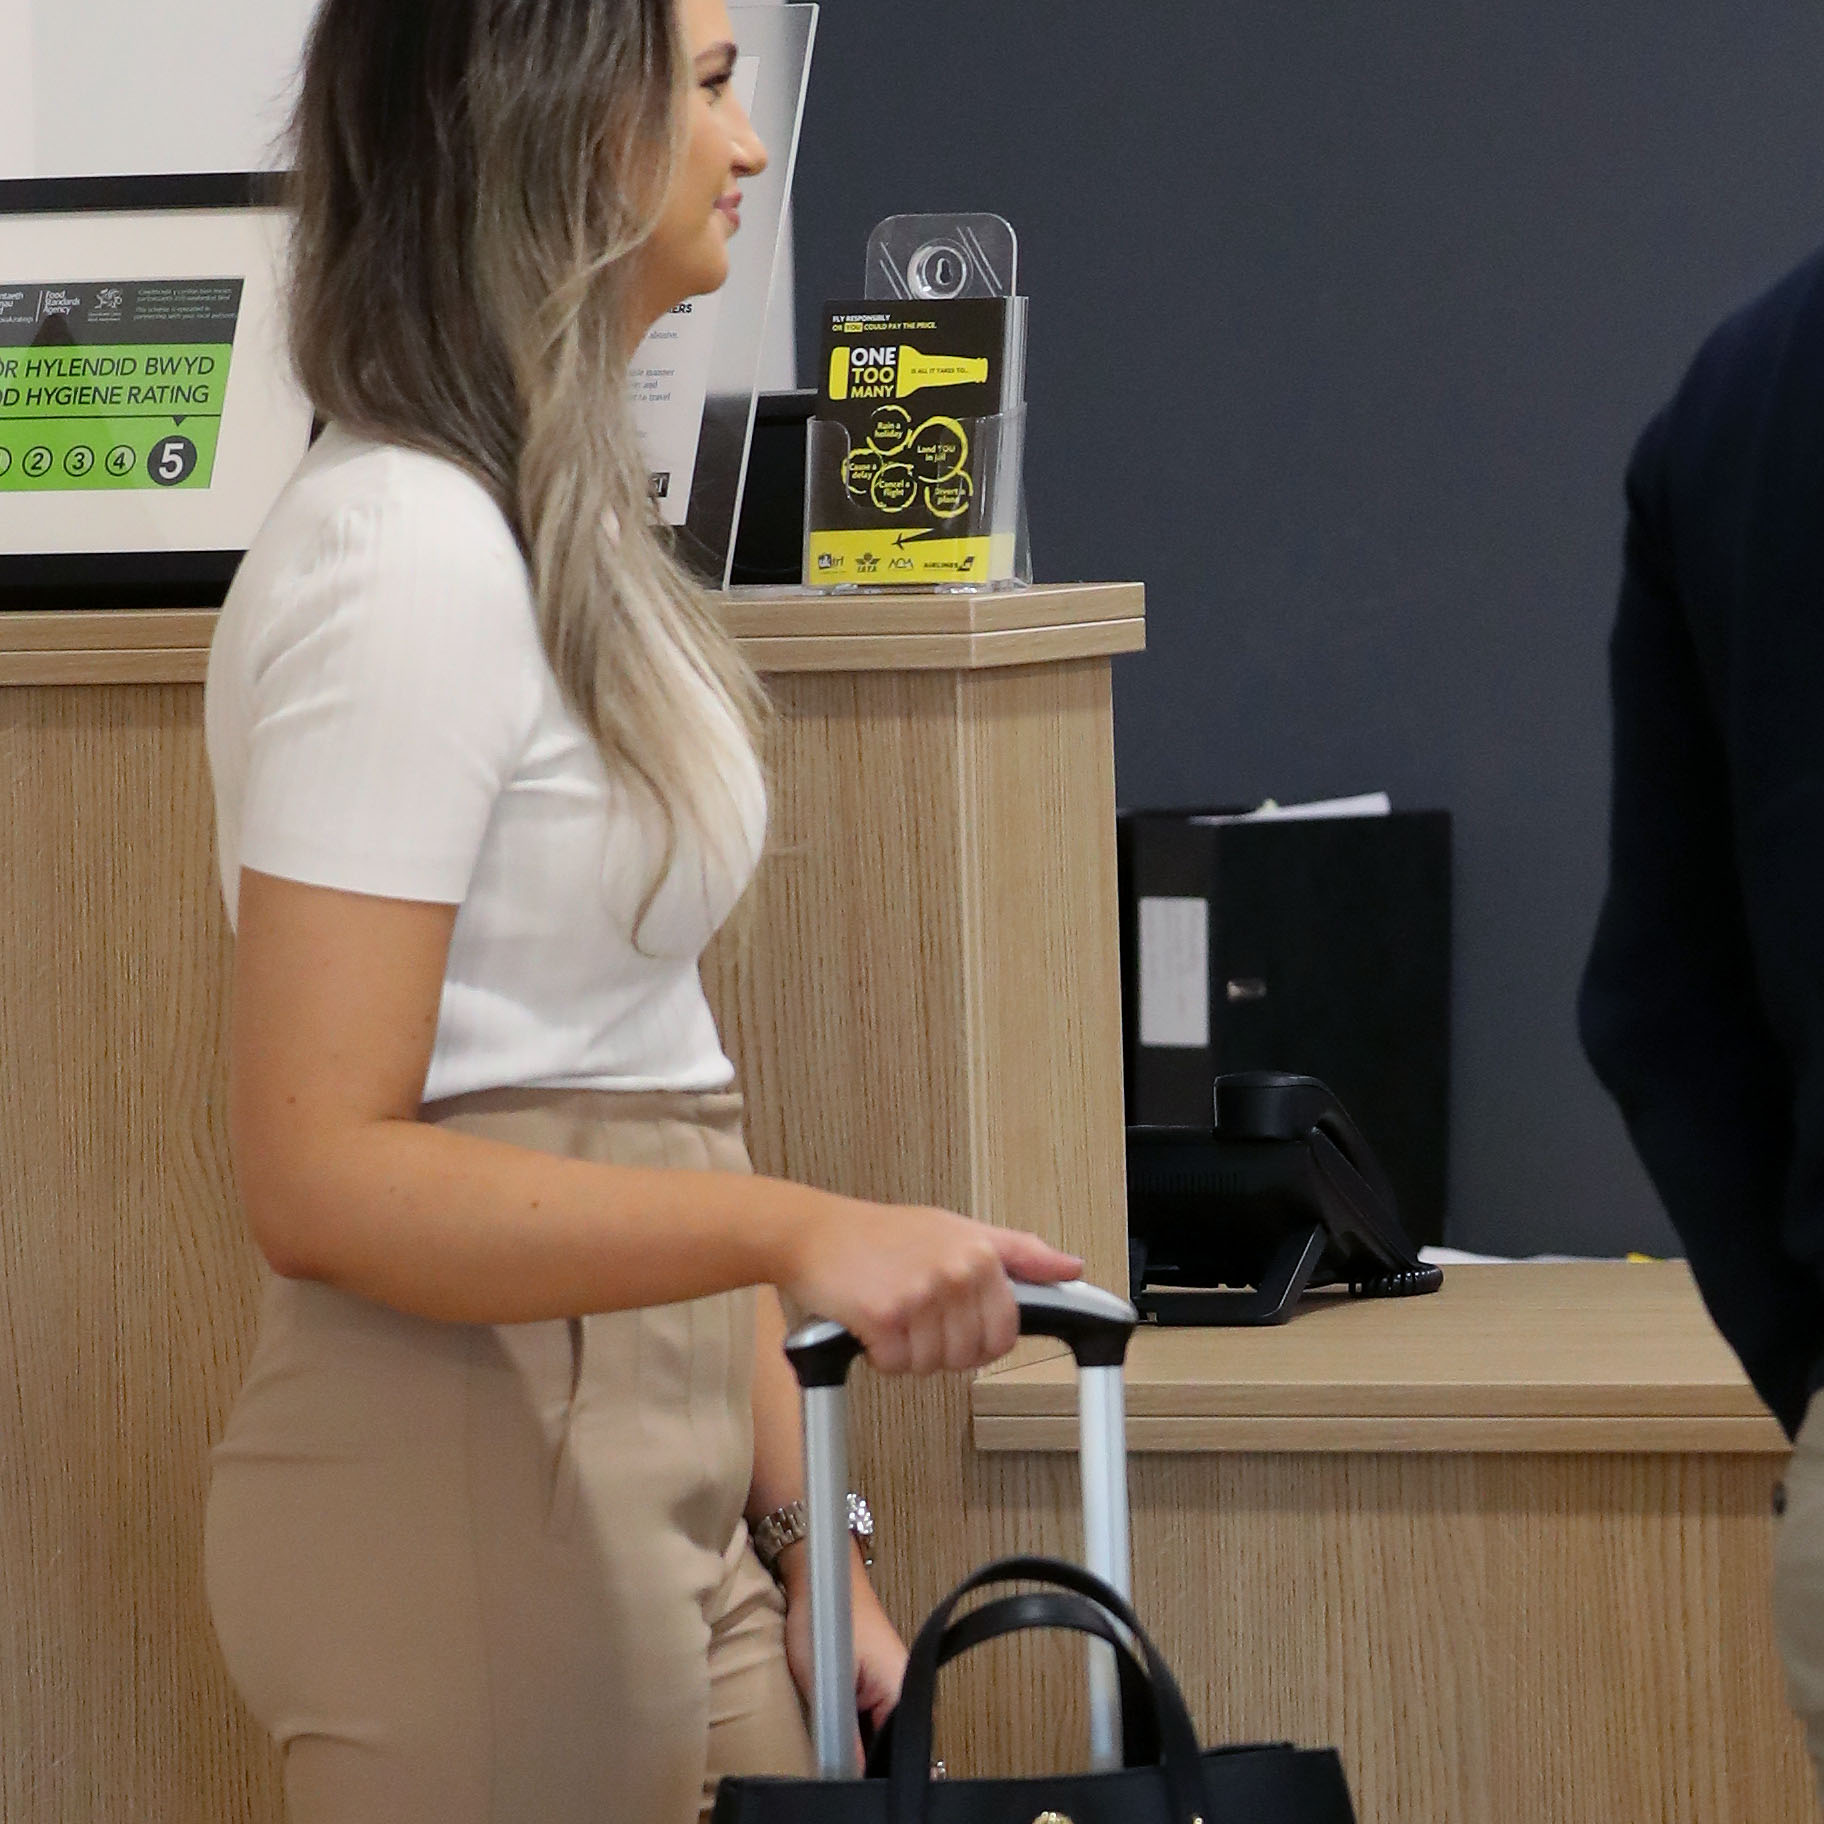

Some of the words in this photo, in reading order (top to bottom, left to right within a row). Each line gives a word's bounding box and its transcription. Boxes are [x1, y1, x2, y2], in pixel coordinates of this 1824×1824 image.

[851, 347, 896, 366] ONE
[25, 357, 138, 378] HYLENDID
[145, 356, 215, 376] BWYD
[851, 367, 895, 384] TOO
[26, 386, 124, 406] HYGIENE
[127, 384, 209, 405] RATING
[851, 385, 894, 399] MANY
[874, 429, 903, 439] holiday
[31, 452, 44, 470] 2
[72, 452, 85, 470] 3
[113, 452, 126, 470] 4
[158, 443, 185, 480] 5
